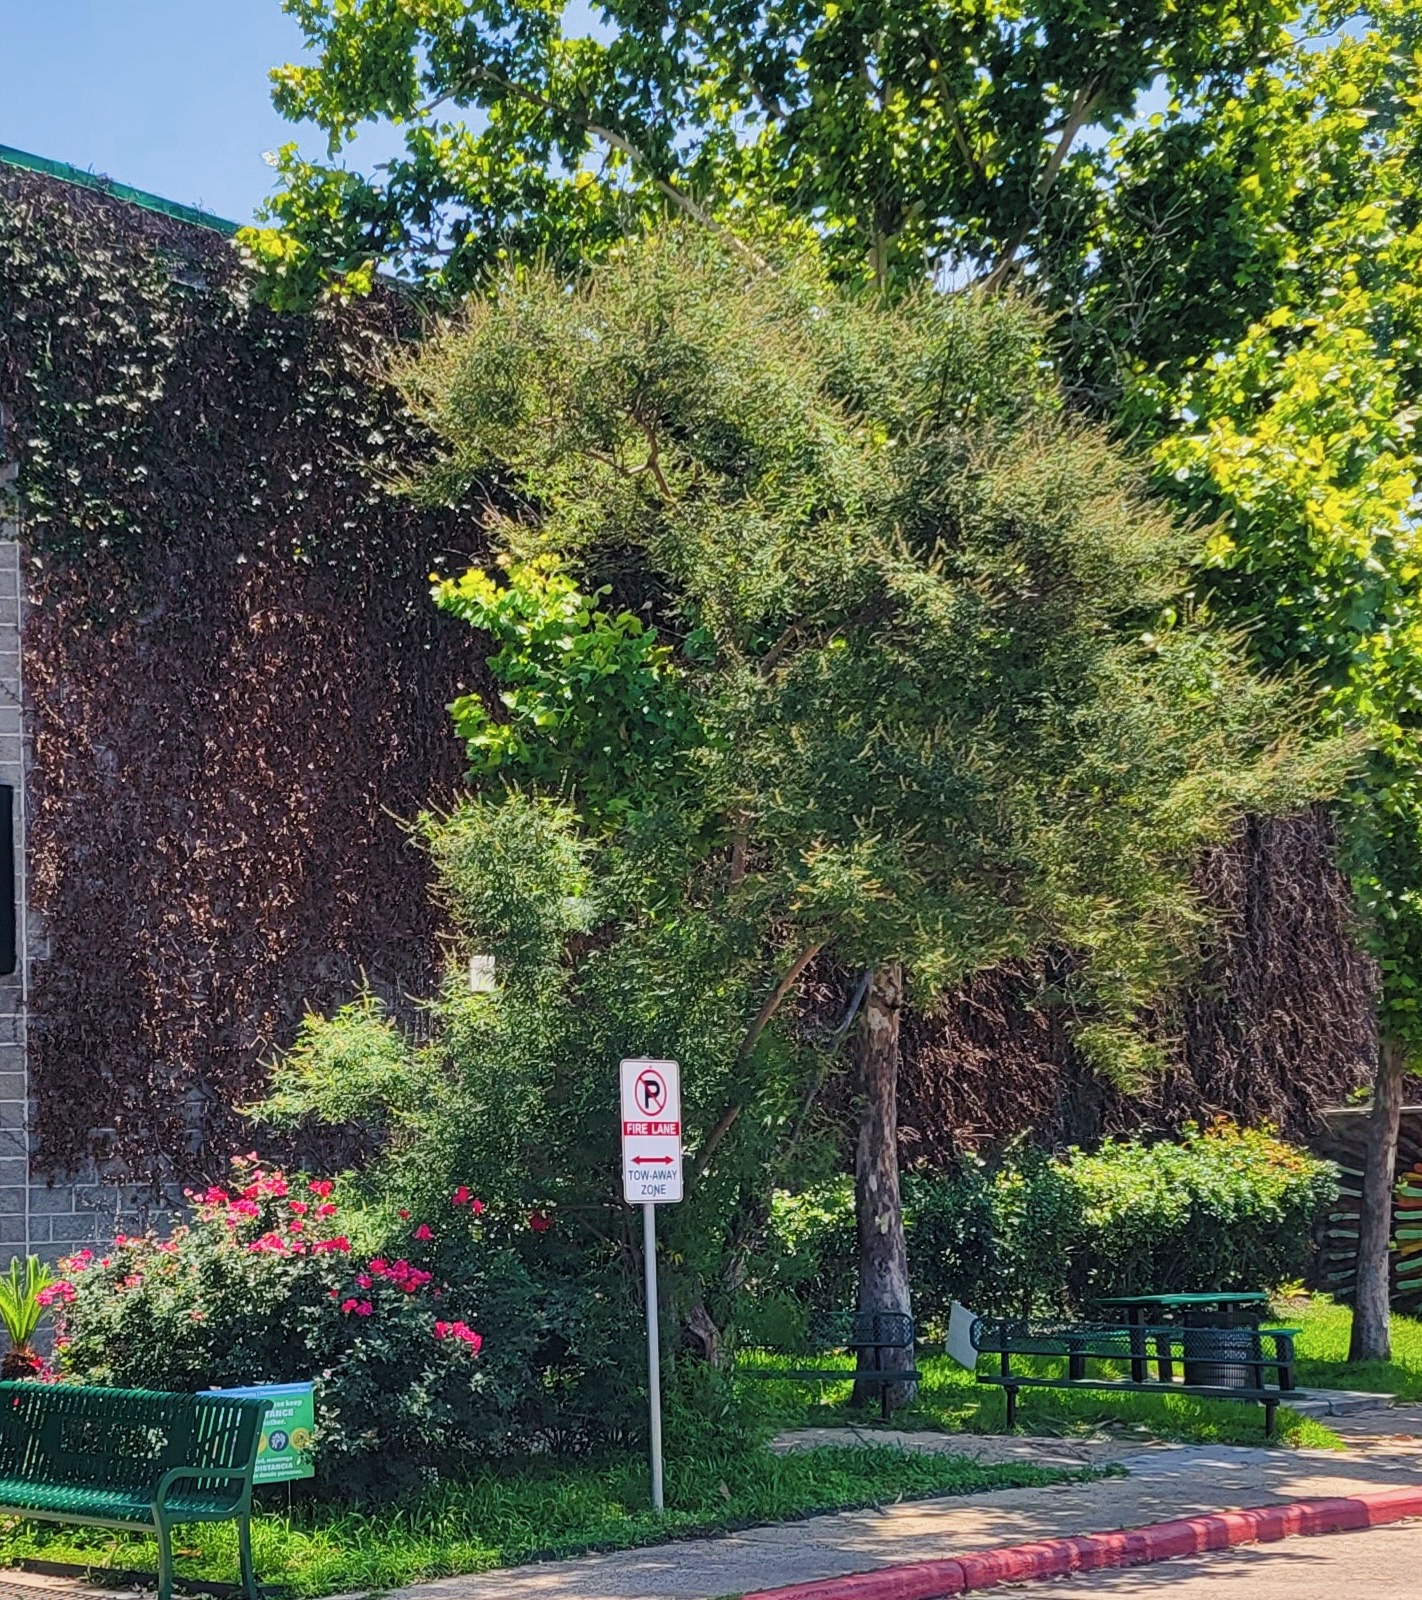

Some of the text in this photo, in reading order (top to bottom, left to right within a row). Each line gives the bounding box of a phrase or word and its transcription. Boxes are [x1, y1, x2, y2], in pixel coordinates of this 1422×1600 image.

[626, 1122, 677, 1135] FIRE LANE
[628, 1169, 678, 1181] TOW-AWAY
[641, 1184, 667, 1196] ZONE
[264, 1408, 294, 1419] TANCE
